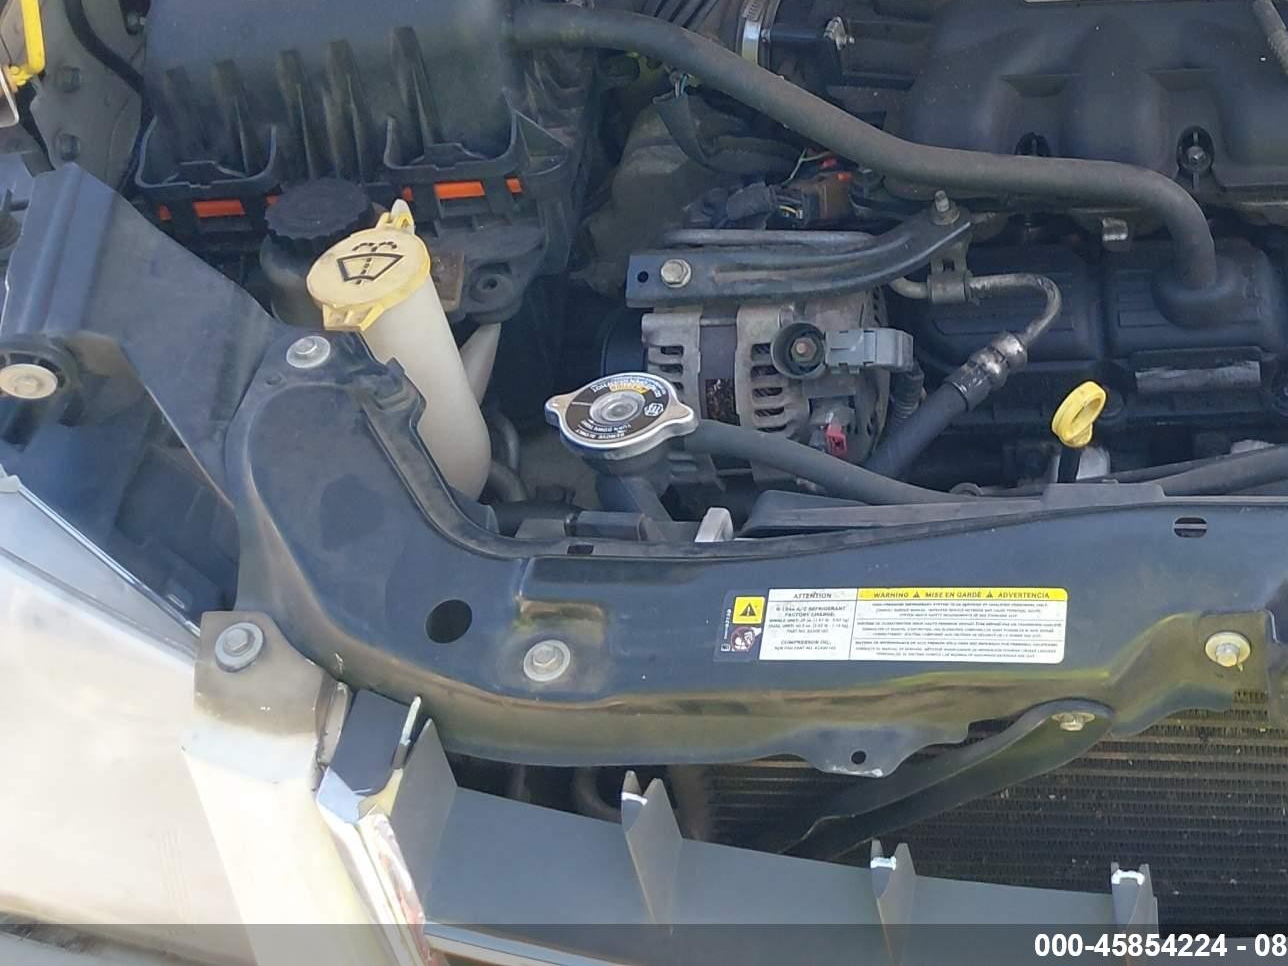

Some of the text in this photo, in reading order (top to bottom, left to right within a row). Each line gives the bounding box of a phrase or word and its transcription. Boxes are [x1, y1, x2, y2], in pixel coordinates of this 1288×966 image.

[873, 591, 909, 599] WARNING
[925, 591, 943, 599] MISE
[956, 591, 981, 599] GARDE
[997, 591, 1050, 599] ADVERTENCIA
